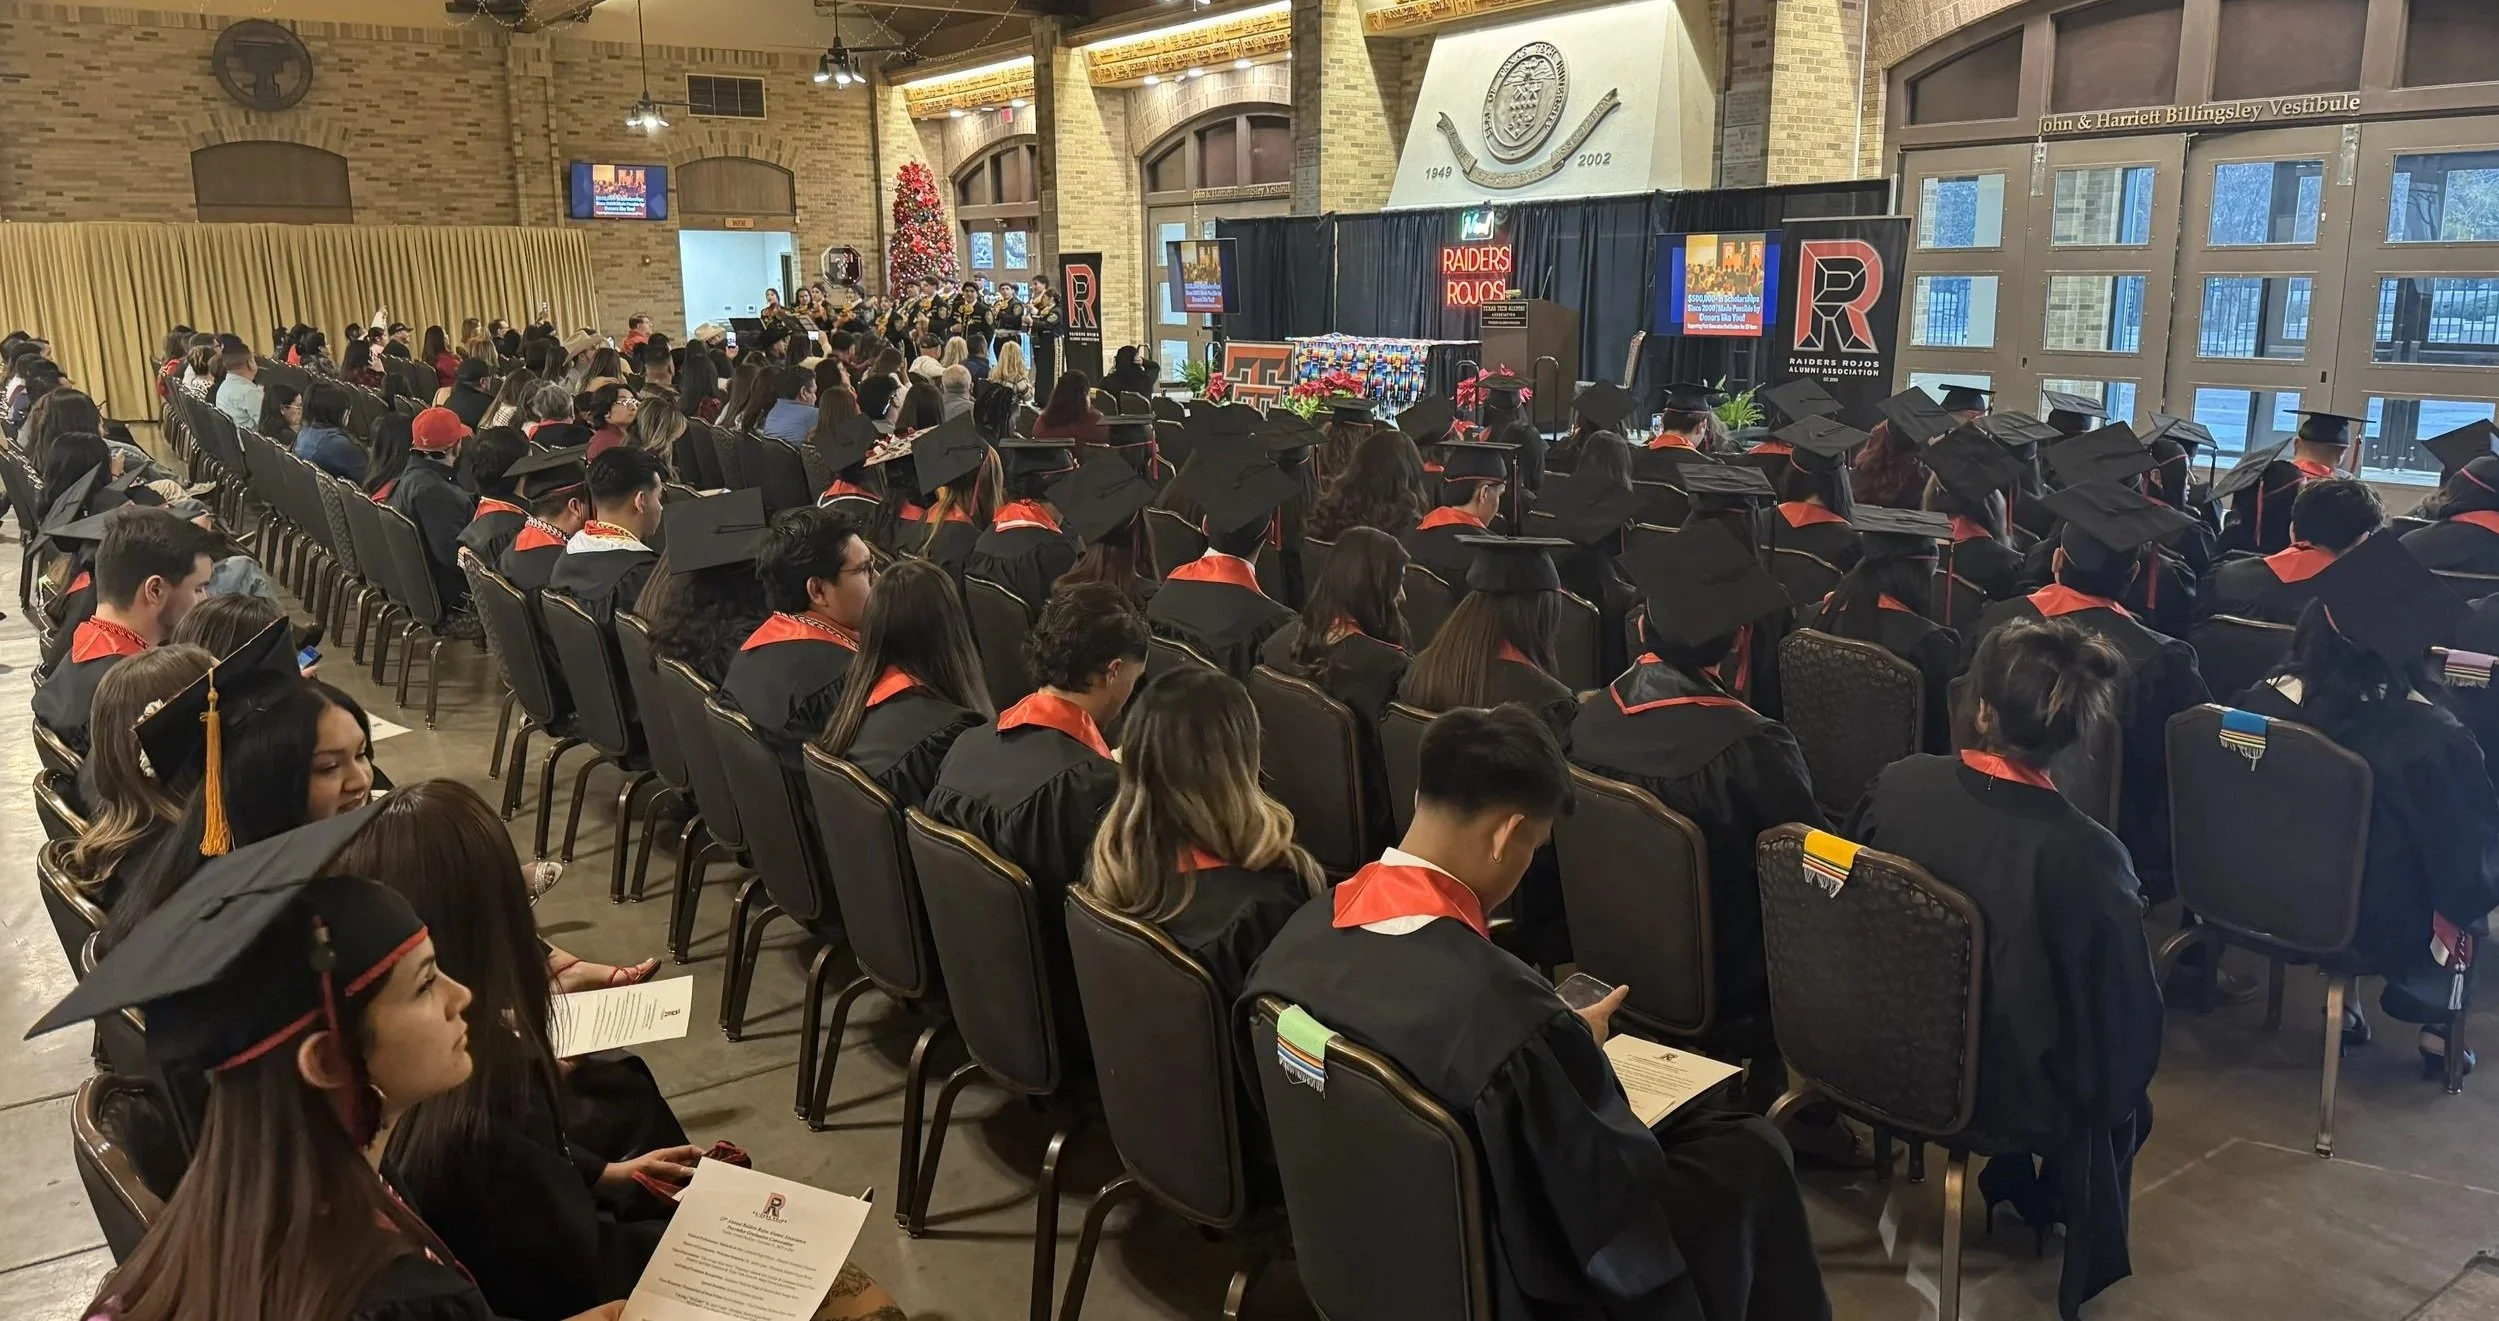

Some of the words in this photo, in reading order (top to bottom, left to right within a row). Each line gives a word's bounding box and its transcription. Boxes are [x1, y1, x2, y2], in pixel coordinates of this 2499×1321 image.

[2037, 117, 2072, 136] John
[2077, 115, 2091, 129] &
[2097, 109, 2160, 128] Harriett
[2165, 100, 2262, 125] Billingsley
[2269, 94, 2361, 116] Vestibule
[1577, 152, 1612, 168] 2002
[1425, 166, 1453, 180] 1949
[1443, 246, 1511, 272] RAIDERS
[1447, 278, 1505, 306] ROJOS
[1688, 304, 1701, 313] Since
[1733, 304, 1754, 313] Possible
[1700, 314, 1720, 322] Donors
[1732, 314, 1746, 322] You!
[1789, 358, 1837, 366] RAIDERS
[1788, 366, 1820, 374] ALUMNI
[1822, 367, 1879, 376] ASSOCIATION
